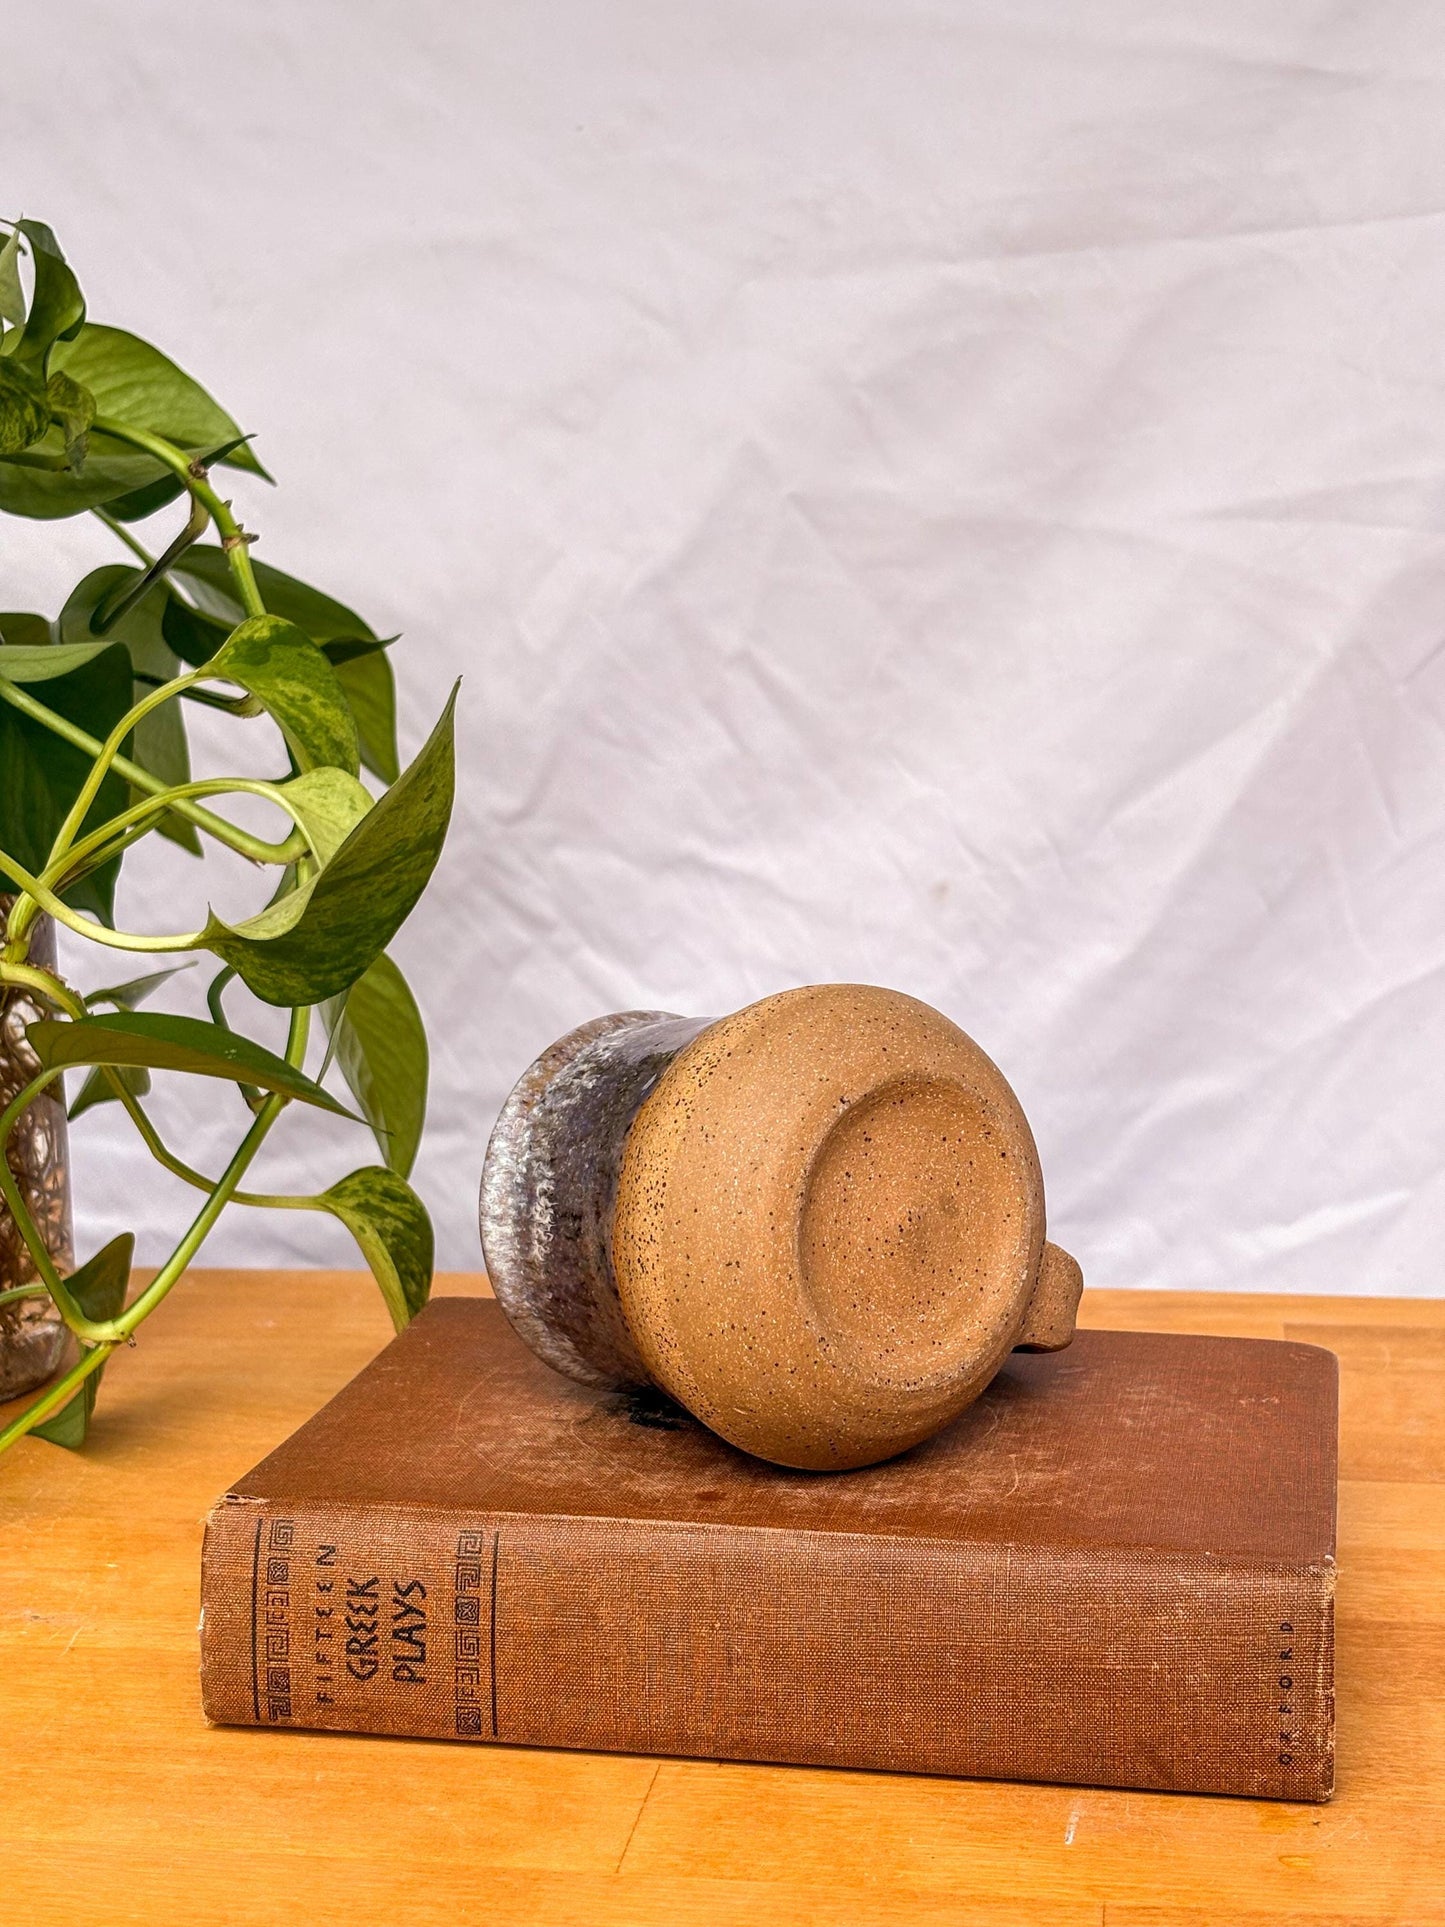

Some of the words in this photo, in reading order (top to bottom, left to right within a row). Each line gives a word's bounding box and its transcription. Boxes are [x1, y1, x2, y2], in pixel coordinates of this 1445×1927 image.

[315, 1544, 336, 1704] FIFTEEN
[345, 1576, 380, 1681] GREEK
[392, 1579, 427, 1684] PLAYS
[1278, 1621, 1294, 1766] OXFORD
